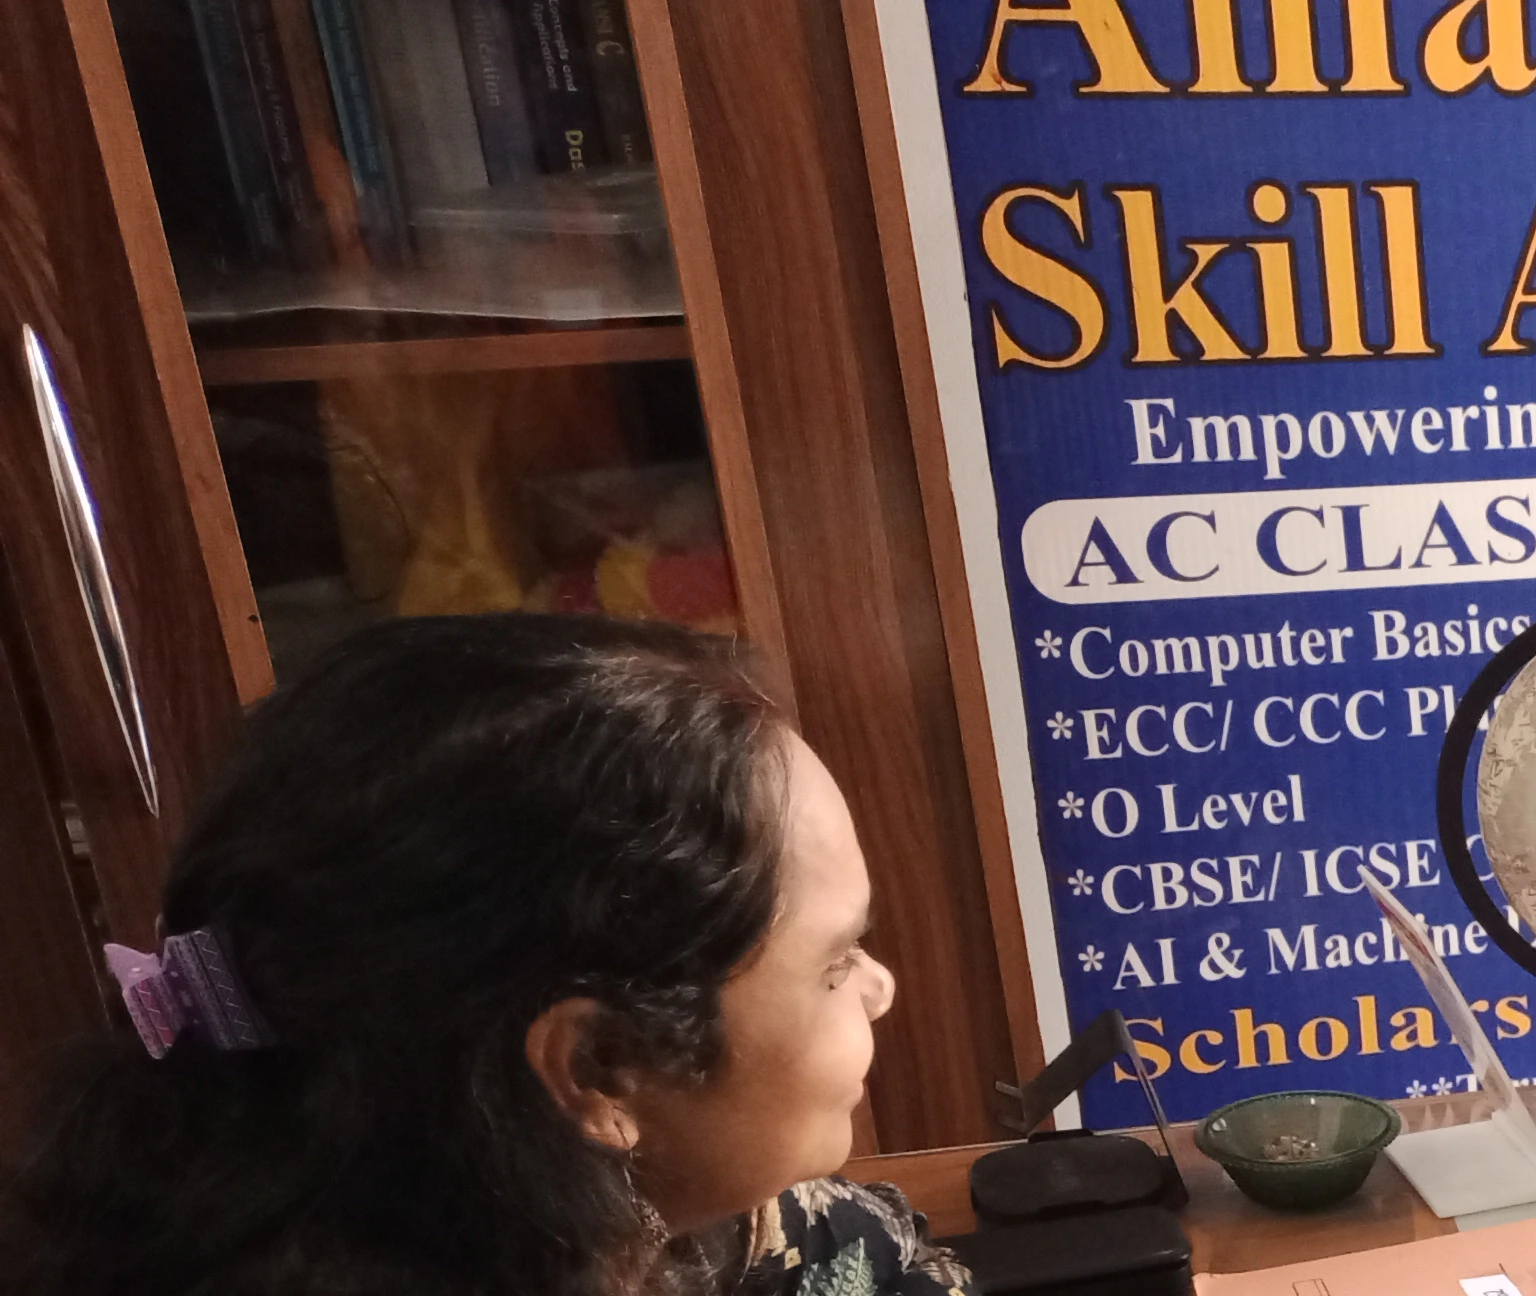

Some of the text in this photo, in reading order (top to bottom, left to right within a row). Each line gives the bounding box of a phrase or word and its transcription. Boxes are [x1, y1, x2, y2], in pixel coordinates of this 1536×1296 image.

[979, 178, 1441, 371] Skill
[1064, 510, 1221, 587] AC
[1252, 689, 1387, 748] CCC
[1157, 774, 1306, 835] Level
[1298, 838, 1441, 899] ICSE
[1199, 931, 1247, 982] &
[1264, 912, 1489, 975] Machne
